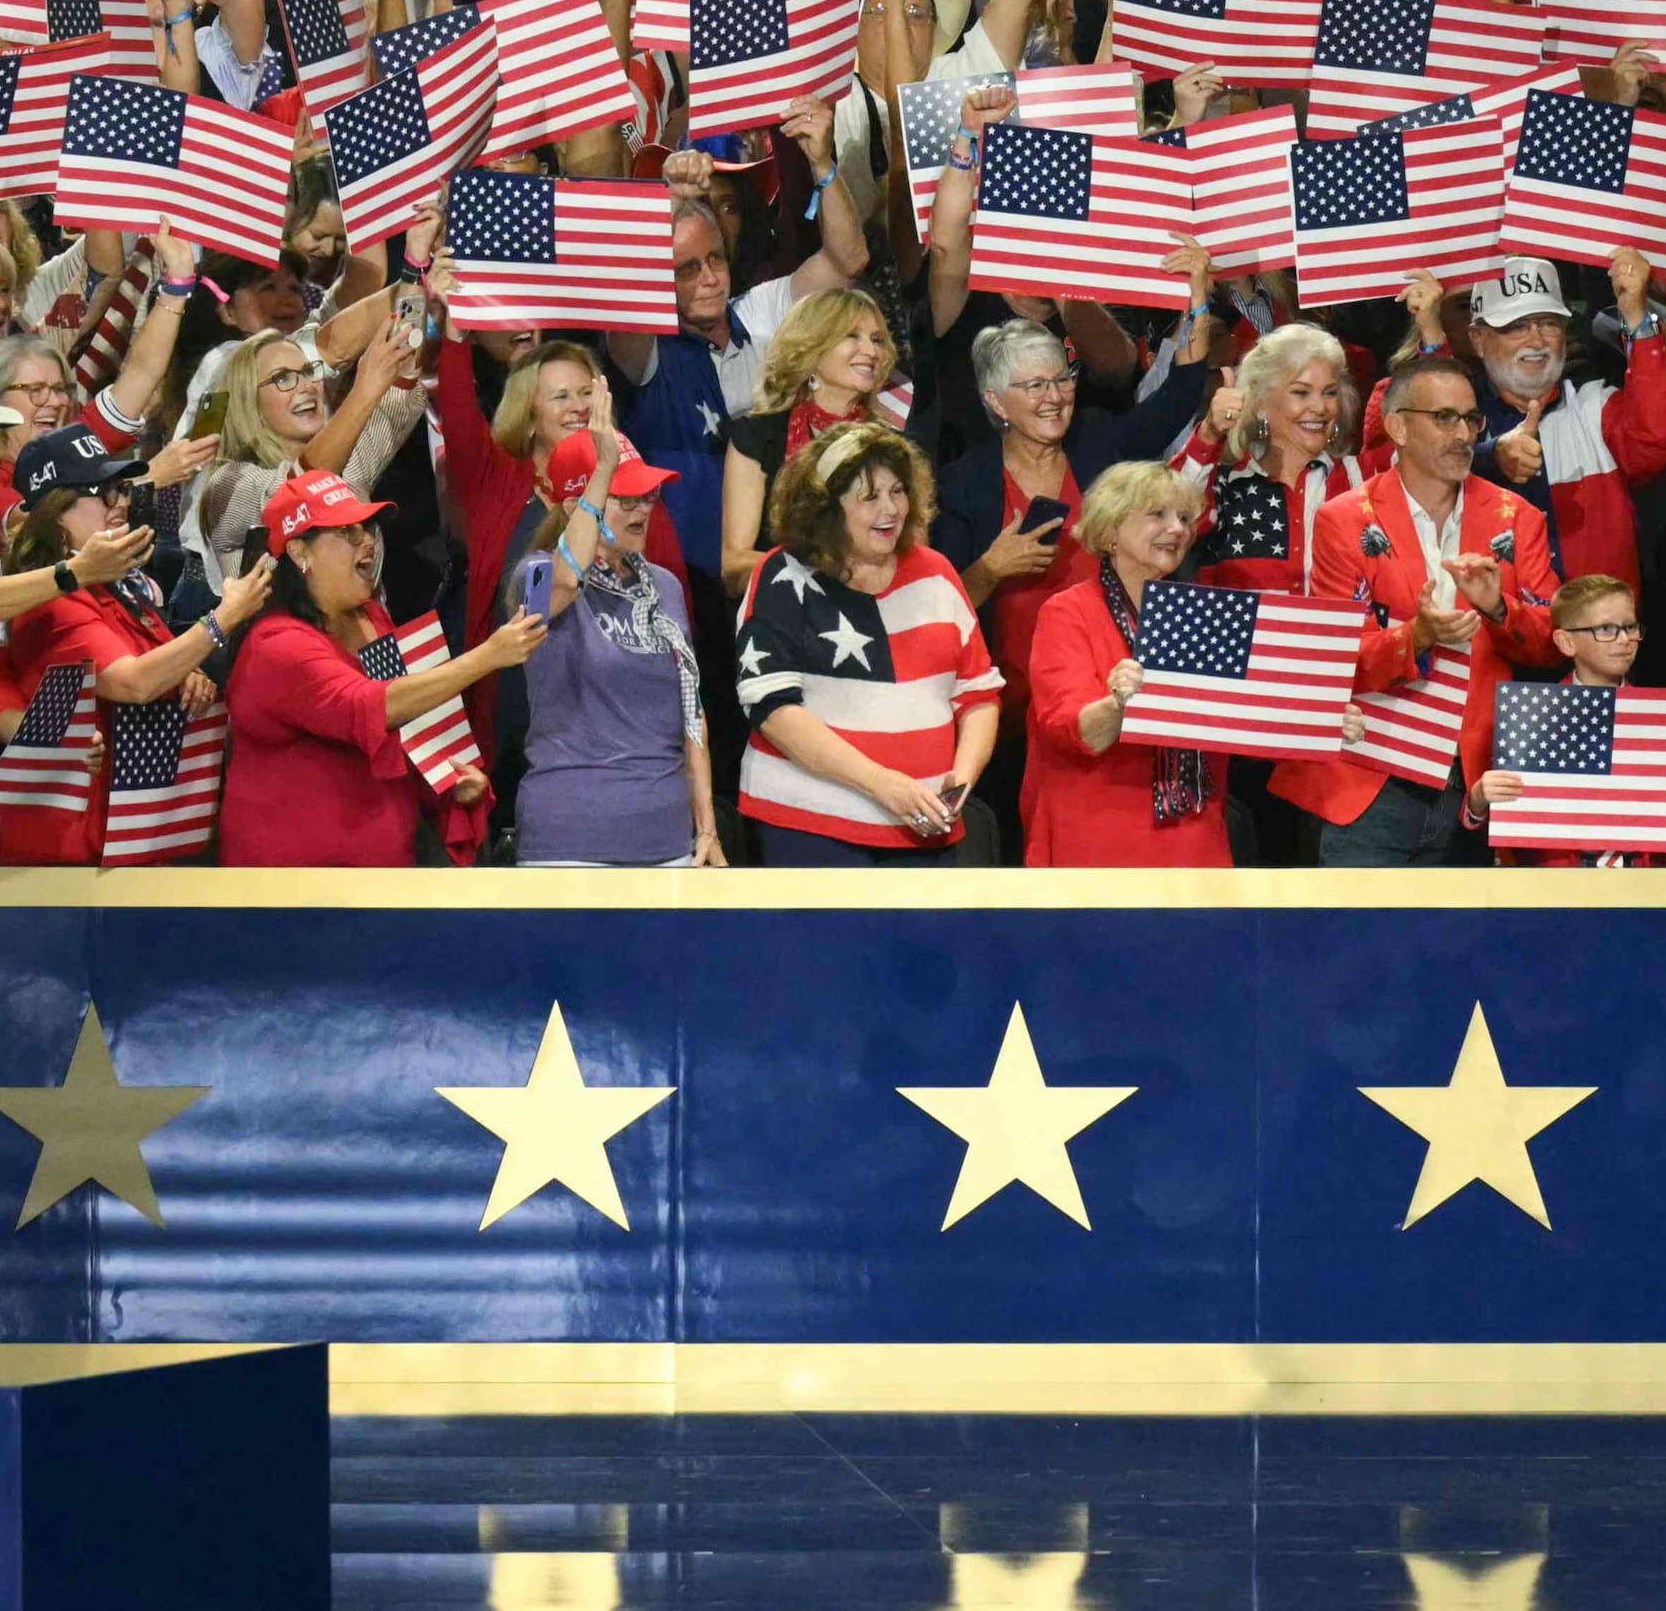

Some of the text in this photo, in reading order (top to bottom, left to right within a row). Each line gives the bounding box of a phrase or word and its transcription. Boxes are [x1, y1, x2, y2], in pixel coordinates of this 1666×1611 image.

[1497, 271, 1550, 298] USA
[71, 434, 109, 458] US
[29, 461, 58, 492] 45-47
[306, 475, 335, 495] MAKE
[282, 503, 312, 535] 45-47
